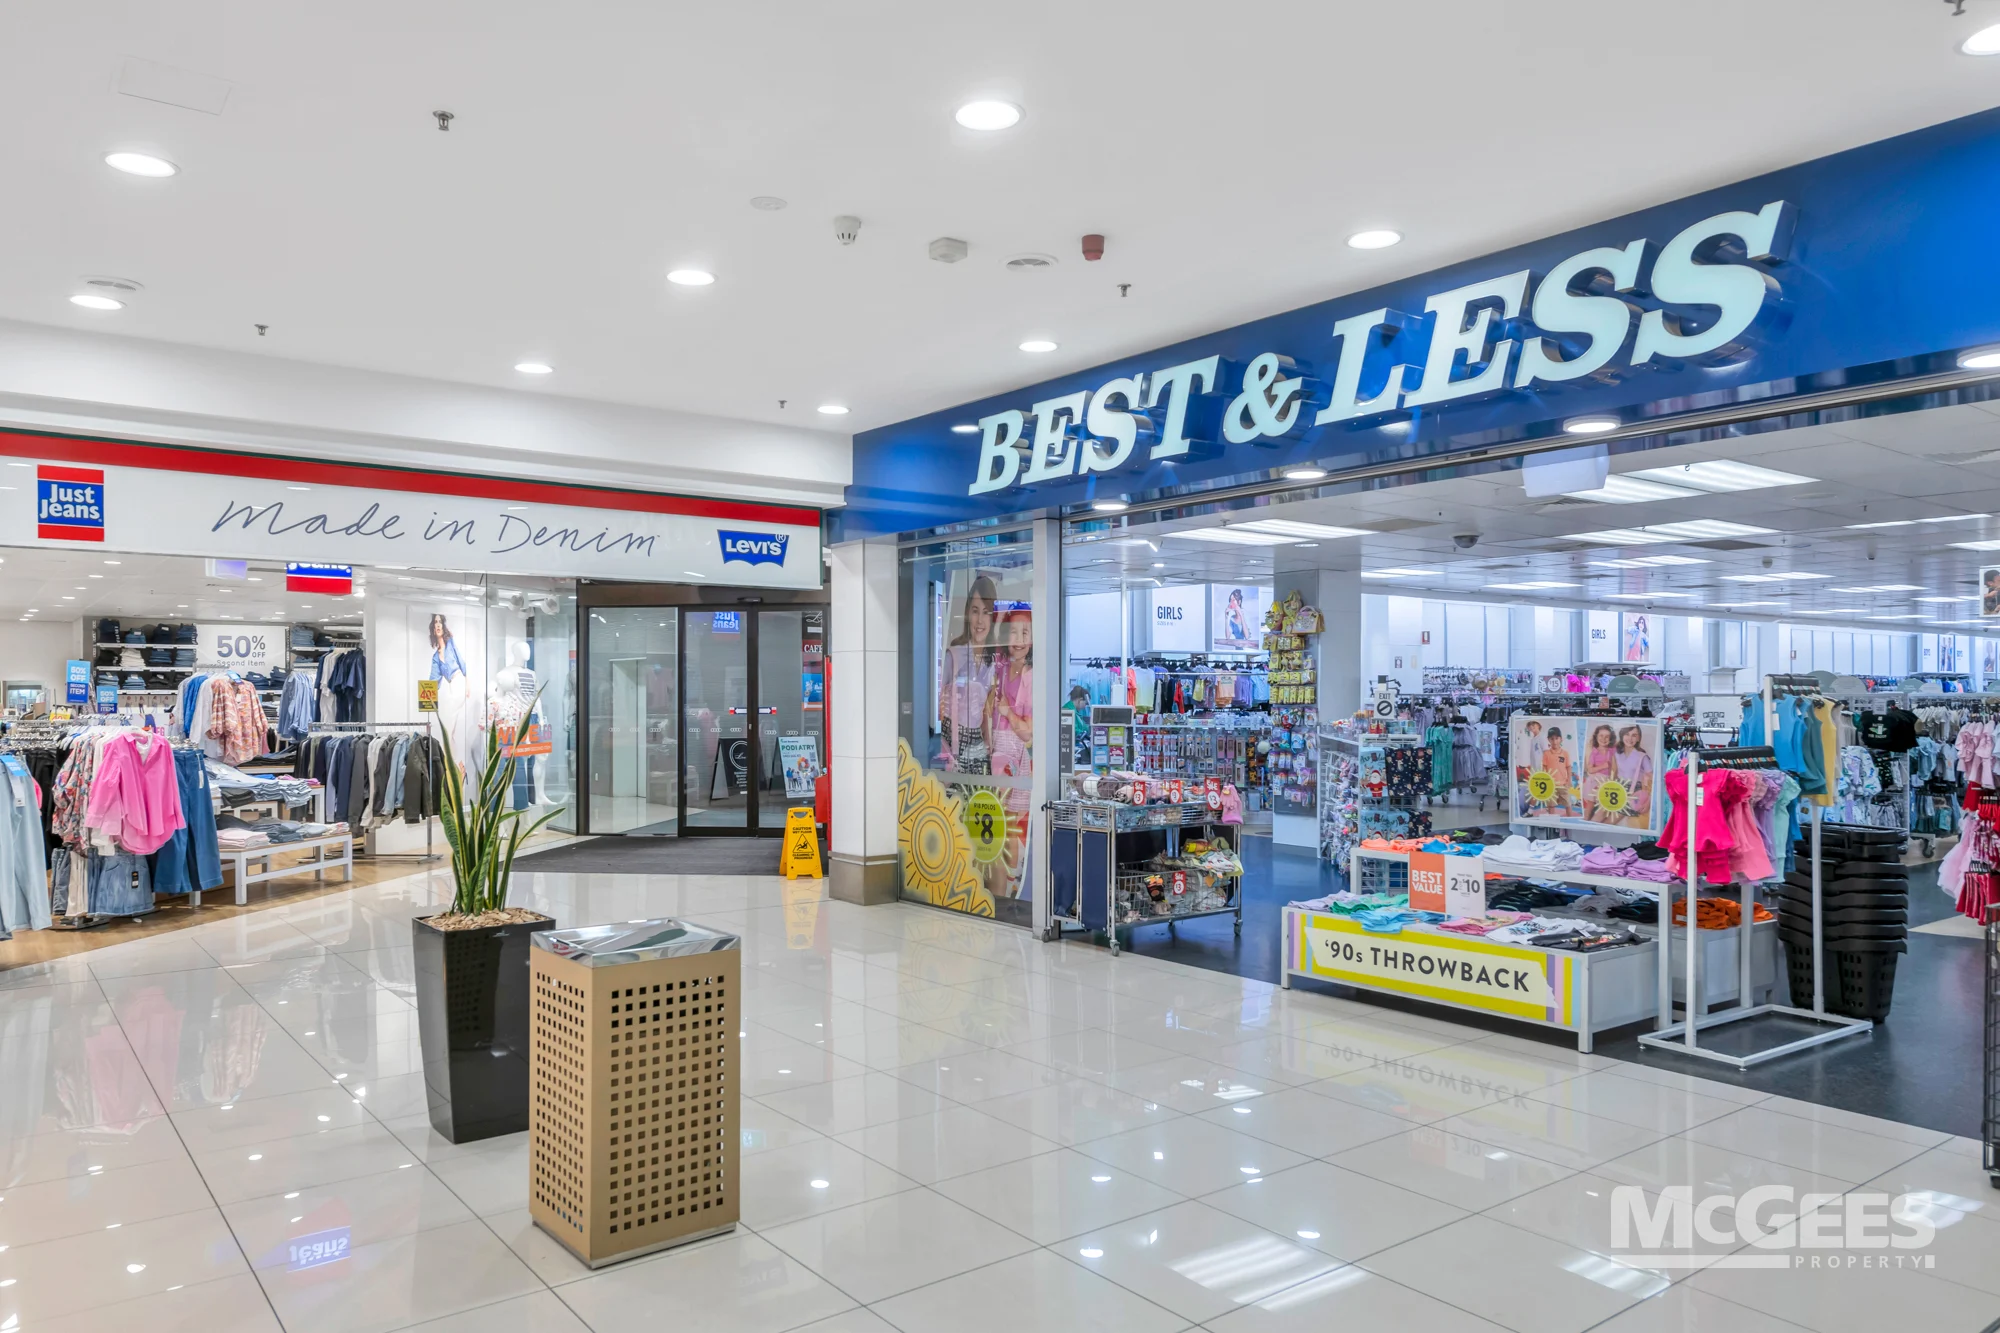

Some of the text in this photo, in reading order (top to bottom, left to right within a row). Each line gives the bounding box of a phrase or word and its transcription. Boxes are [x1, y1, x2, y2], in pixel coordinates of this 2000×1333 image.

[968, 200, 1788, 496] BEST & LESS
[49, 483, 95, 504] Just
[39, 499, 100, 520] Jeans
[423, 511, 476, 546] in
[490, 514, 660, 557] Denim
[1157, 605, 1183, 620] GIRLS
[1591, 629, 1607, 640] GIRLS
[1535, 781, 1547, 795] $9
[1605, 791, 1619, 805] $8
[974, 812, 994, 845] $8
[1411, 869, 1443, 885] BEST
[1411, 881, 1443, 895] VALUE
[1370, 947, 1530, 993] THROWBACK
